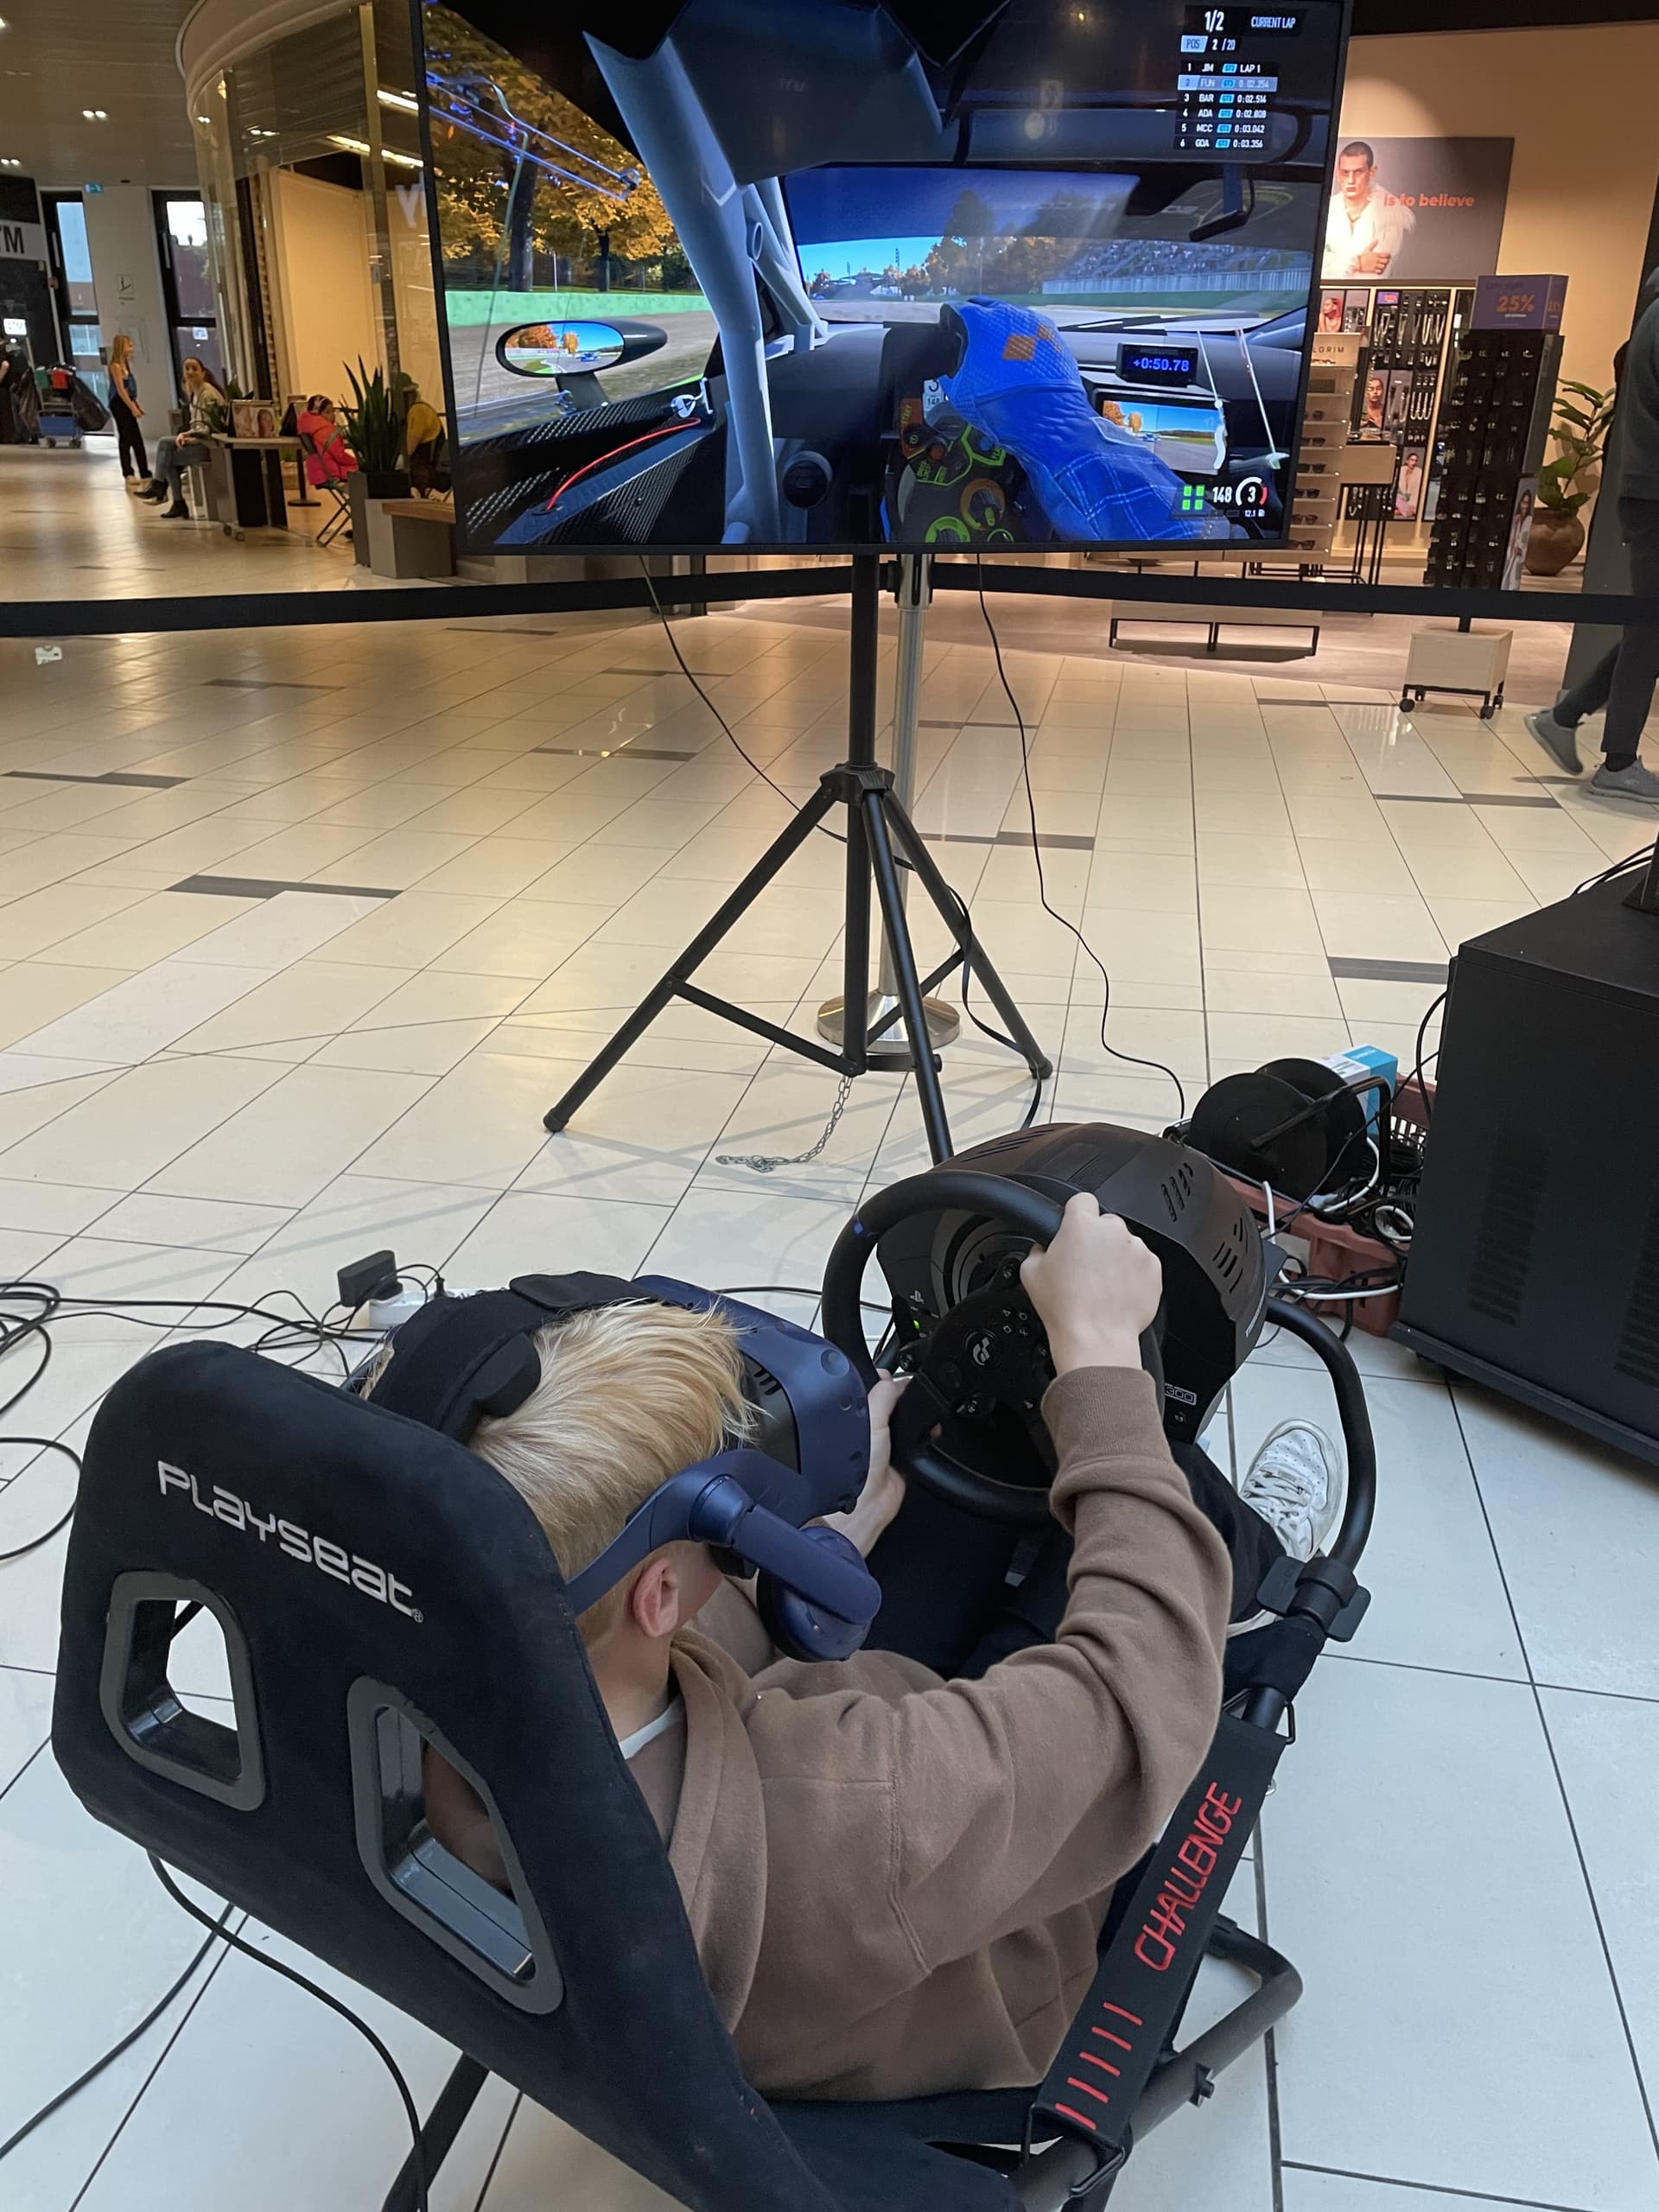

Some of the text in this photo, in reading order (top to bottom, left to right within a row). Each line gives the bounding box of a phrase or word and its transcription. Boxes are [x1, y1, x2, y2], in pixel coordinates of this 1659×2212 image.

[1205, 10, 1224, 33] 1/2
[1251, 16, 1296, 29] CURRENT LAP
[1186, 39, 1200, 49] POS
[1240, 64, 1255, 73] LAP
[1184, 93, 1190, 102] 3
[1181, 124, 1187, 132] 5
[1400, 194, 1415, 207] to
[1419, 194, 1475, 207] believe
[1497, 295, 1535, 312] 25%
[1133, 357, 1190, 372] +0:50.78
[1212, 486, 1256, 503] 148 3
[1134, 1782, 1243, 1971] CHALLENGE
